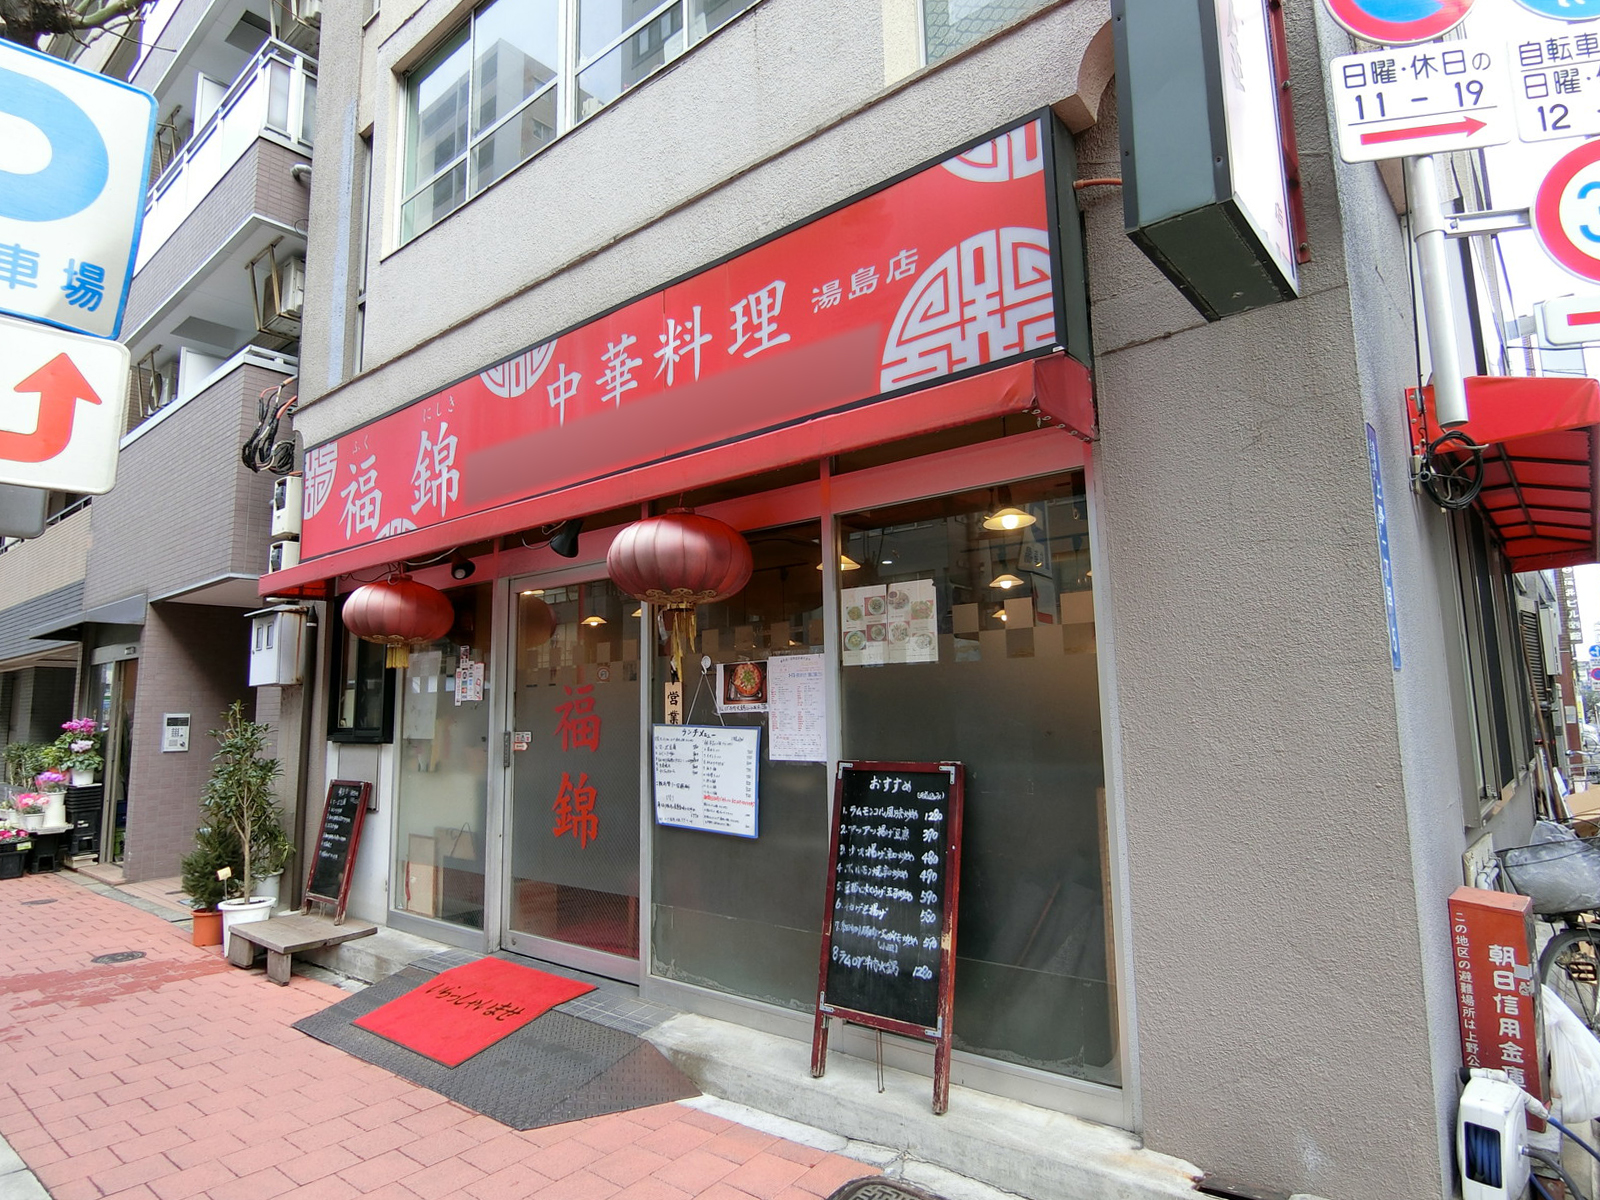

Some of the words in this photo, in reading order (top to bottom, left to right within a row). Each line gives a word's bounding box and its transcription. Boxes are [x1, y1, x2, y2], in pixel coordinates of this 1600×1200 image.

[1518, 32, 1600, 67] 自転車
[1342, 49, 1492, 89] 日曜・休日の
[810, 247, 919, 315] 湯島店
[546, 279, 792, 429] 中華料理
[421, 394, 456, 424] にしき
[351, 433, 370, 455] ふく
[338, 421, 461, 541] 福錦
[667, 690, 680, 725] 営業
[550, 683, 602, 850] 福錦
[869, 775, 912, 793] おすすめ
[924, 807, 944, 821] 1280
[922, 828, 939, 843] 390
[921, 849, 939, 865] 480
[919, 868, 938, 885] 490
